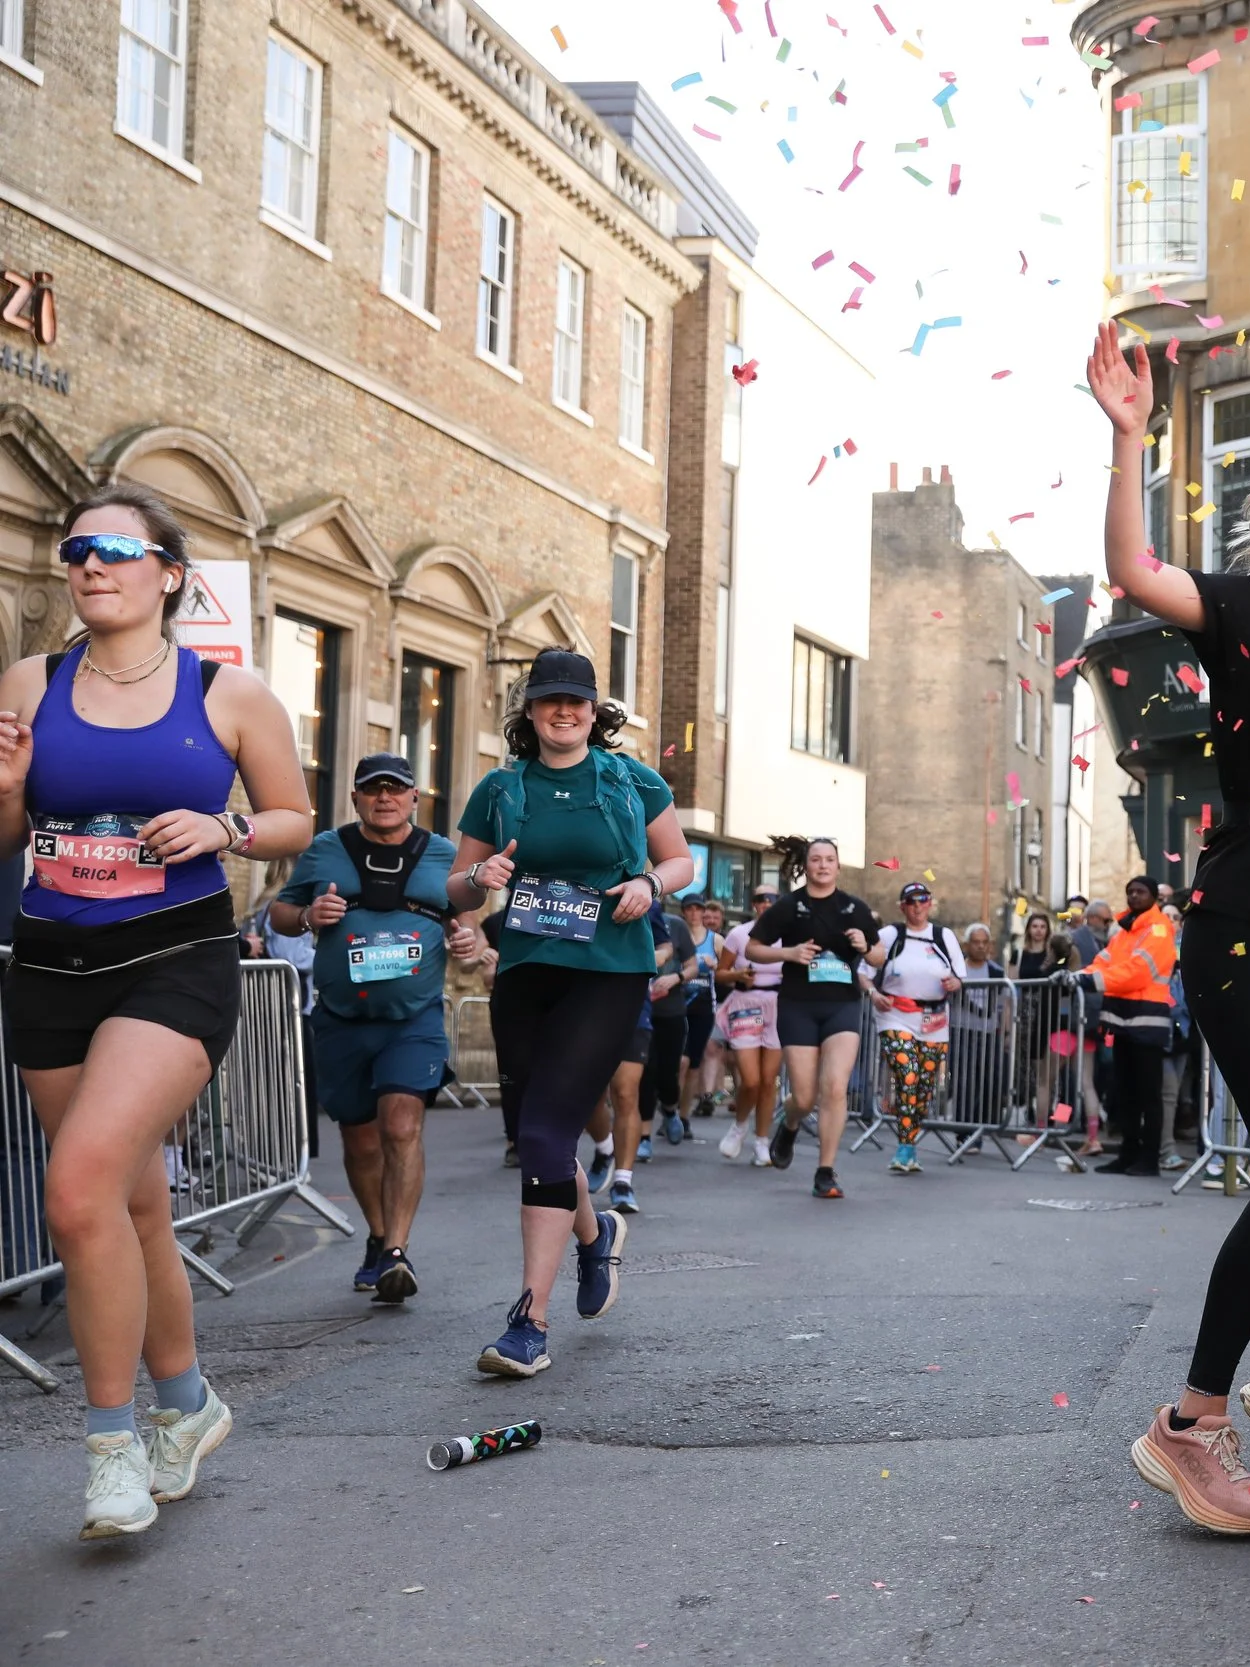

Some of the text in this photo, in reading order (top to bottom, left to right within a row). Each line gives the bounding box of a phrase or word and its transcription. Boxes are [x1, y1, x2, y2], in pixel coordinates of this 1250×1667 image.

[58, 840, 137, 862] M.14290
[71, 866, 118, 881] ERICA
[532, 897, 582, 915] K.11544
[536, 914, 568, 927] EMMA
[374, 962, 400, 971] DAVID
